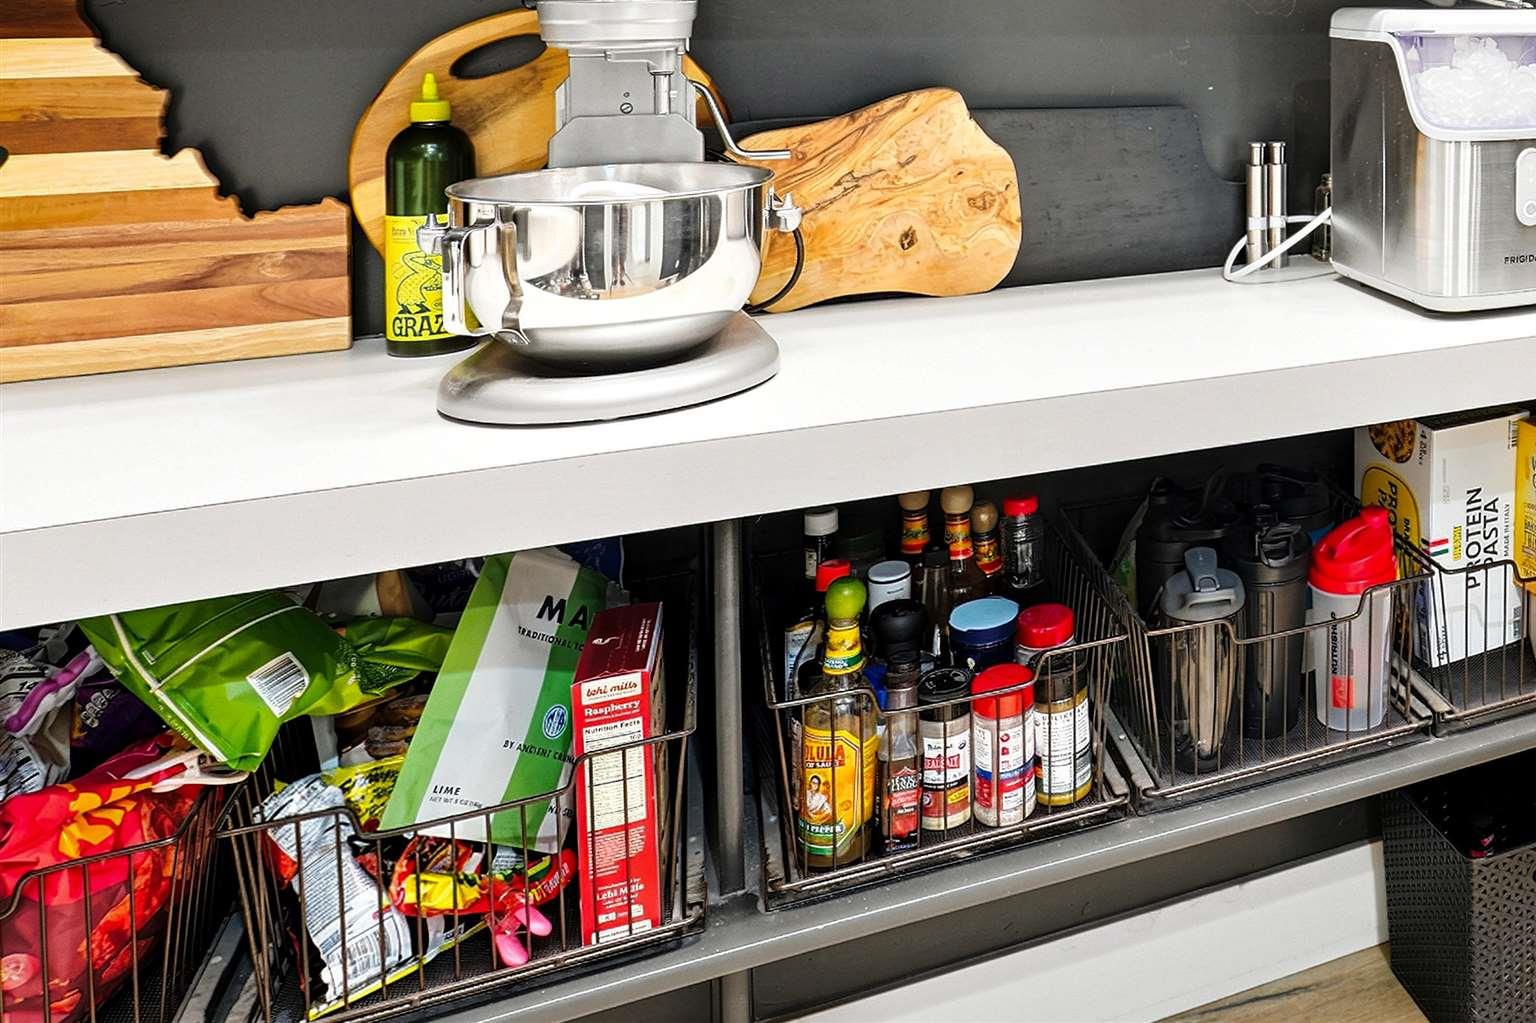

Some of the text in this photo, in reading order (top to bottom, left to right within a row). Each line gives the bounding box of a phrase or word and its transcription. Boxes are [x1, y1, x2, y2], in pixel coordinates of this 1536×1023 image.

[1465, 487, 1483, 589] PROTEIN
[1483, 497, 1499, 568] PASTA
[518, 625, 572, 649] TRADITIONAL
[610, 680, 638, 692] mills
[584, 699, 641, 717] Raspberry
[585, 719, 641, 735] Nutrition Facts
[503, 739, 514, 749] BY
[517, 743, 551, 759] ANCIENT
[433, 784, 461, 796] LIME
